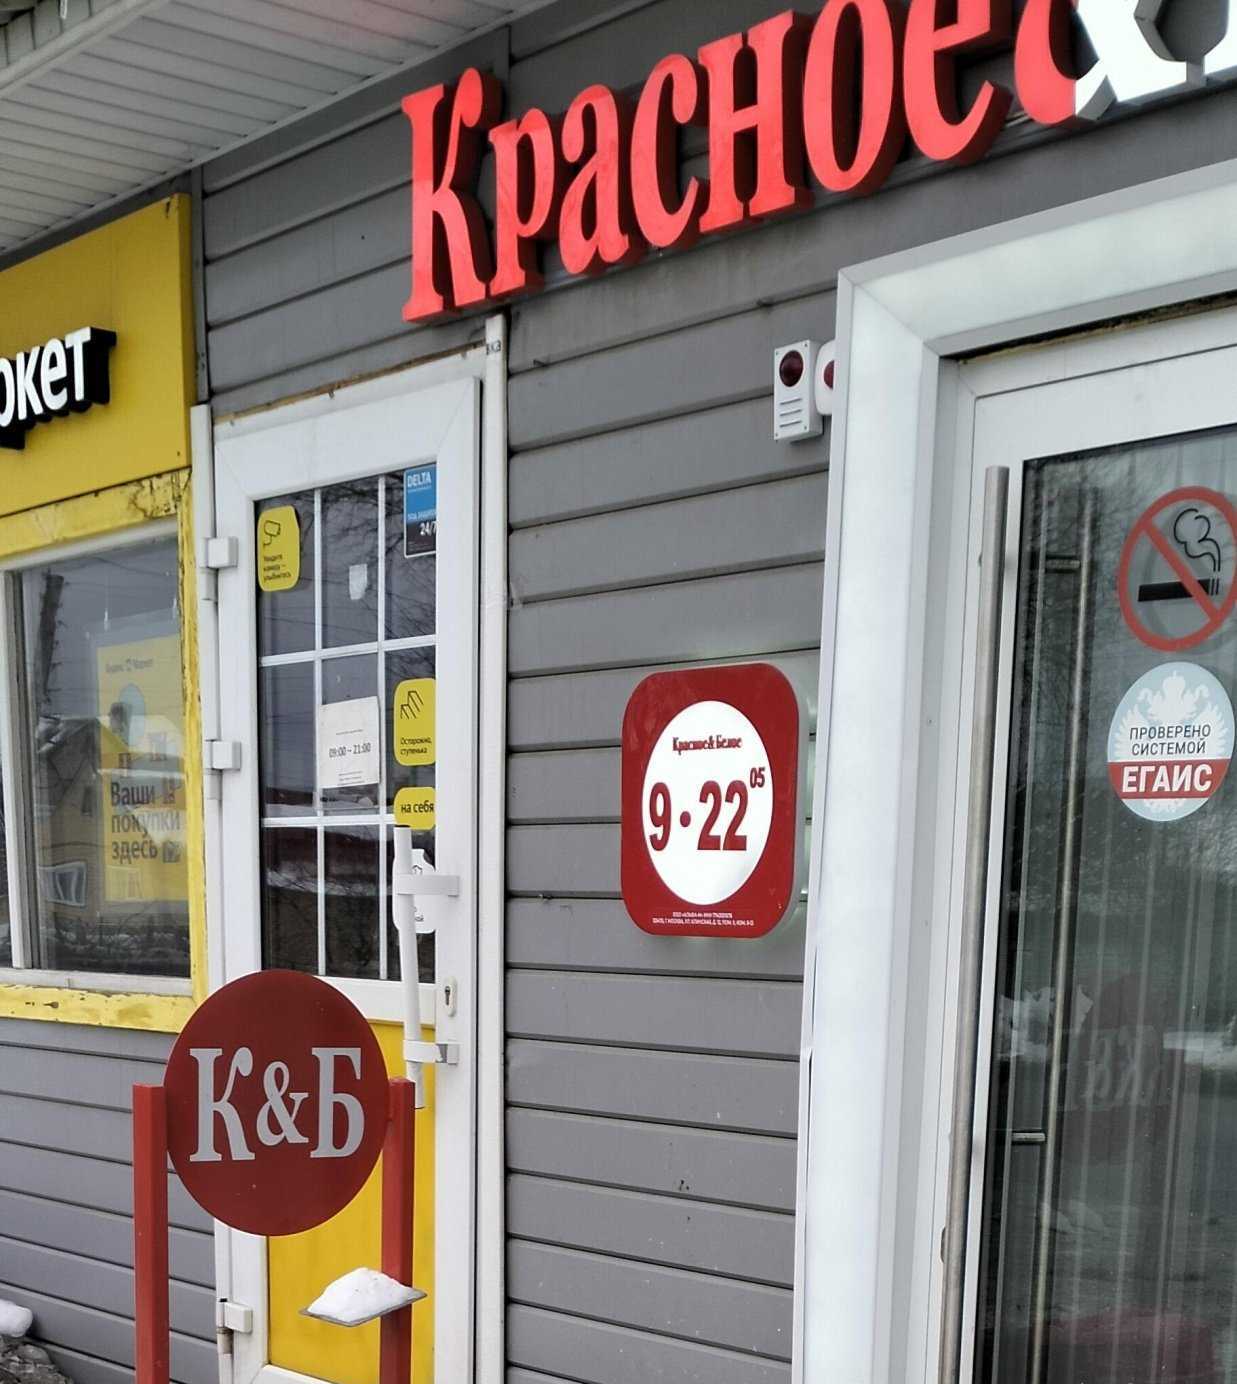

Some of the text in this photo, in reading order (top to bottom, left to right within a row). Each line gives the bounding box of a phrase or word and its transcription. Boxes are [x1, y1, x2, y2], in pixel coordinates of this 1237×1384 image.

[407, 471, 432, 488] DELTA
[1129, 724, 1210, 739] ПРОВЕРЕНО
[1131, 738, 1206, 756] СИСТЕМОЙ
[1121, 764, 1213, 793] ЕГАИС
[110, 782, 157, 806] Ваши
[401, 800, 434, 813] на себя
[111, 811, 182, 838] покупки
[111, 841, 158, 864] здесь
[190, 1046, 365, 1162] К&Б
